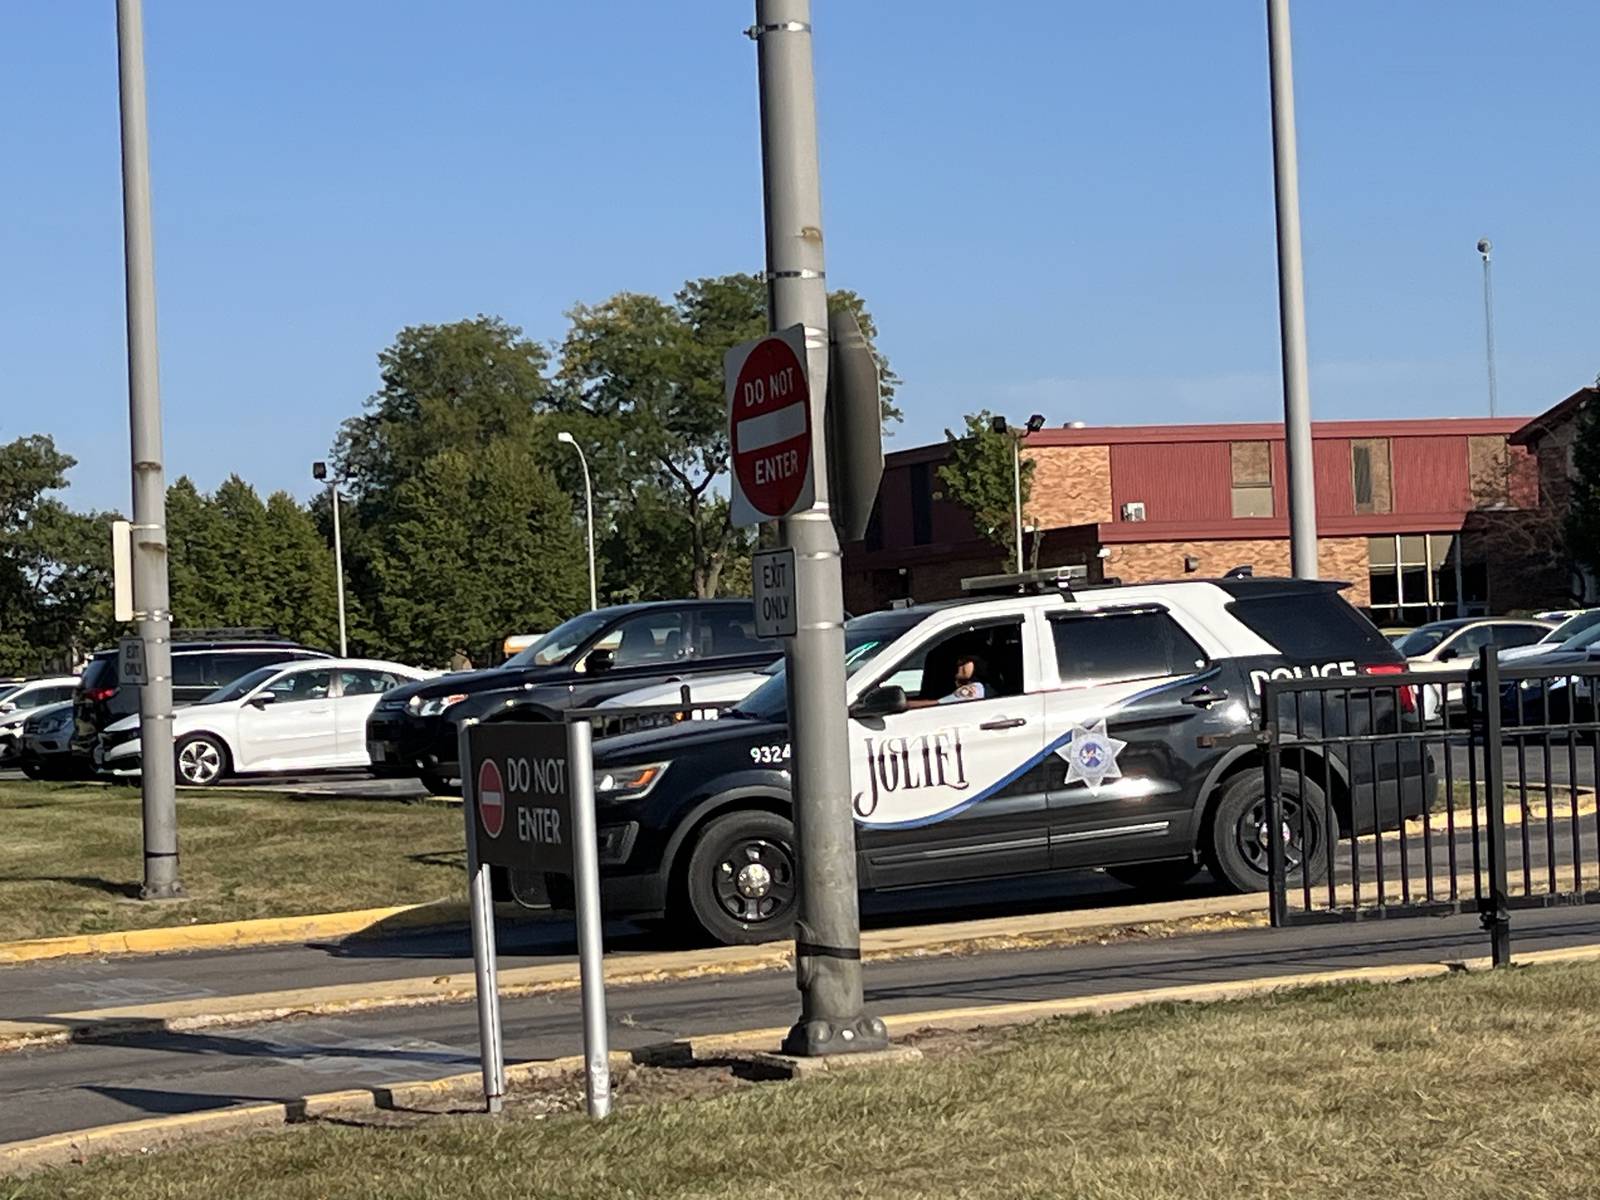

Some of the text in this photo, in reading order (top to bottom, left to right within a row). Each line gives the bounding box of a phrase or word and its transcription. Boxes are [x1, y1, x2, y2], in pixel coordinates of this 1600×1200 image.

[744, 367, 794, 407] DO NOT
[755, 450, 799, 485] ENTER
[763, 563, 786, 588] EXIT
[763, 596, 790, 621] ONLY
[750, 743, 791, 763] 9324
[507, 758, 565, 794] DO NOT
[853, 726, 970, 817] JOLIET
[517, 807, 562, 843] ENTER
